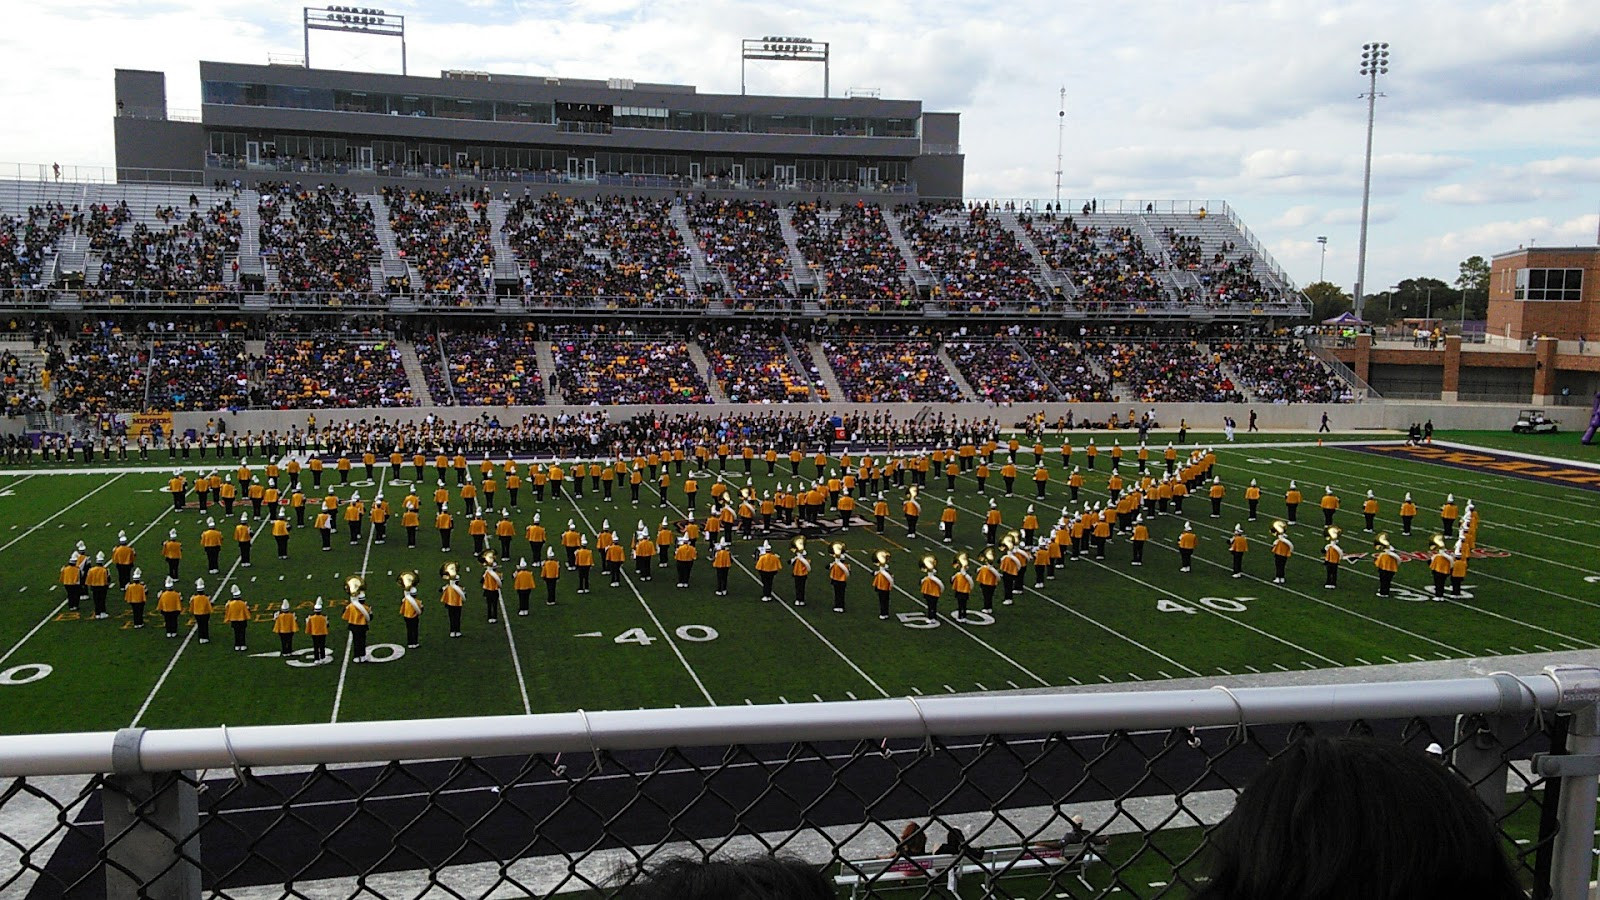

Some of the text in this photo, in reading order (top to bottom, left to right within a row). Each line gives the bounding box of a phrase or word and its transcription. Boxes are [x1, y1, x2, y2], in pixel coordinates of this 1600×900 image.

[1157, 597, 1247, 614] 40
[896, 610, 996, 629] 50
[614, 625, 719, 645] 40
[285, 643, 405, 667] 30
